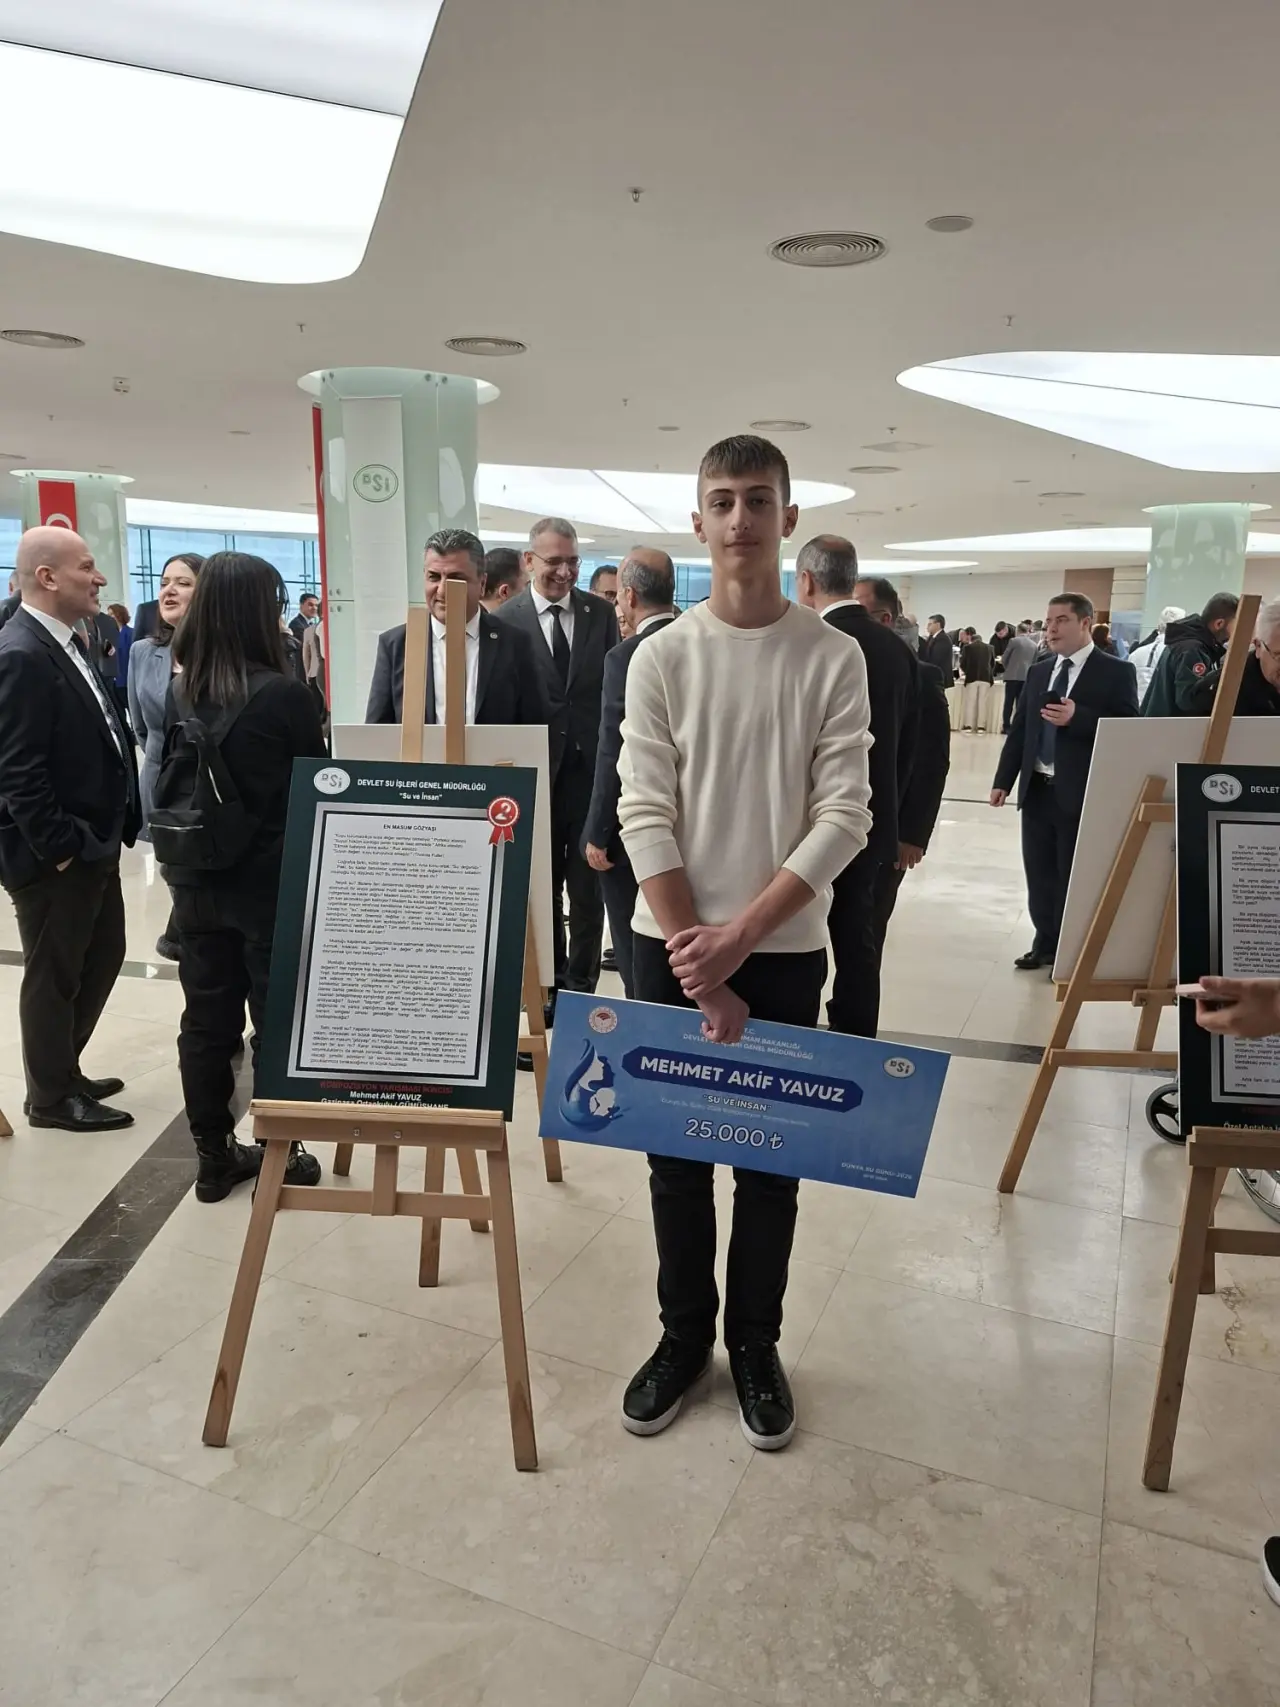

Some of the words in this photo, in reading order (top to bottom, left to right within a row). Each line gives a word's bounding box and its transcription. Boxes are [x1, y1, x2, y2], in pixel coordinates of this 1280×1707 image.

[358, 778, 384, 787] DEVLET
[385, 780, 394, 788] SU
[396, 779, 418, 788] İŞLERİ
[419, 781, 442, 789] GENEL
[443, 782, 486, 791] MÜDÜRLÜĞÜ
[1250, 785, 1280, 794] DEVLET
[400, 792, 412, 800] "Su
[421, 792, 443, 800] İnsan"
[640, 1055, 724, 1083] MEHMET
[728, 1066, 773, 1091] AKİF
[779, 1077, 845, 1103] YAVUZ
[350, 1090, 379, 1099] Mehmet
[380, 1092, 396, 1100] Akif
[397, 1093, 422, 1101] YAVUZ
[723, 1096, 736, 1106] VE
[684, 1118, 766, 1148] 25.000
